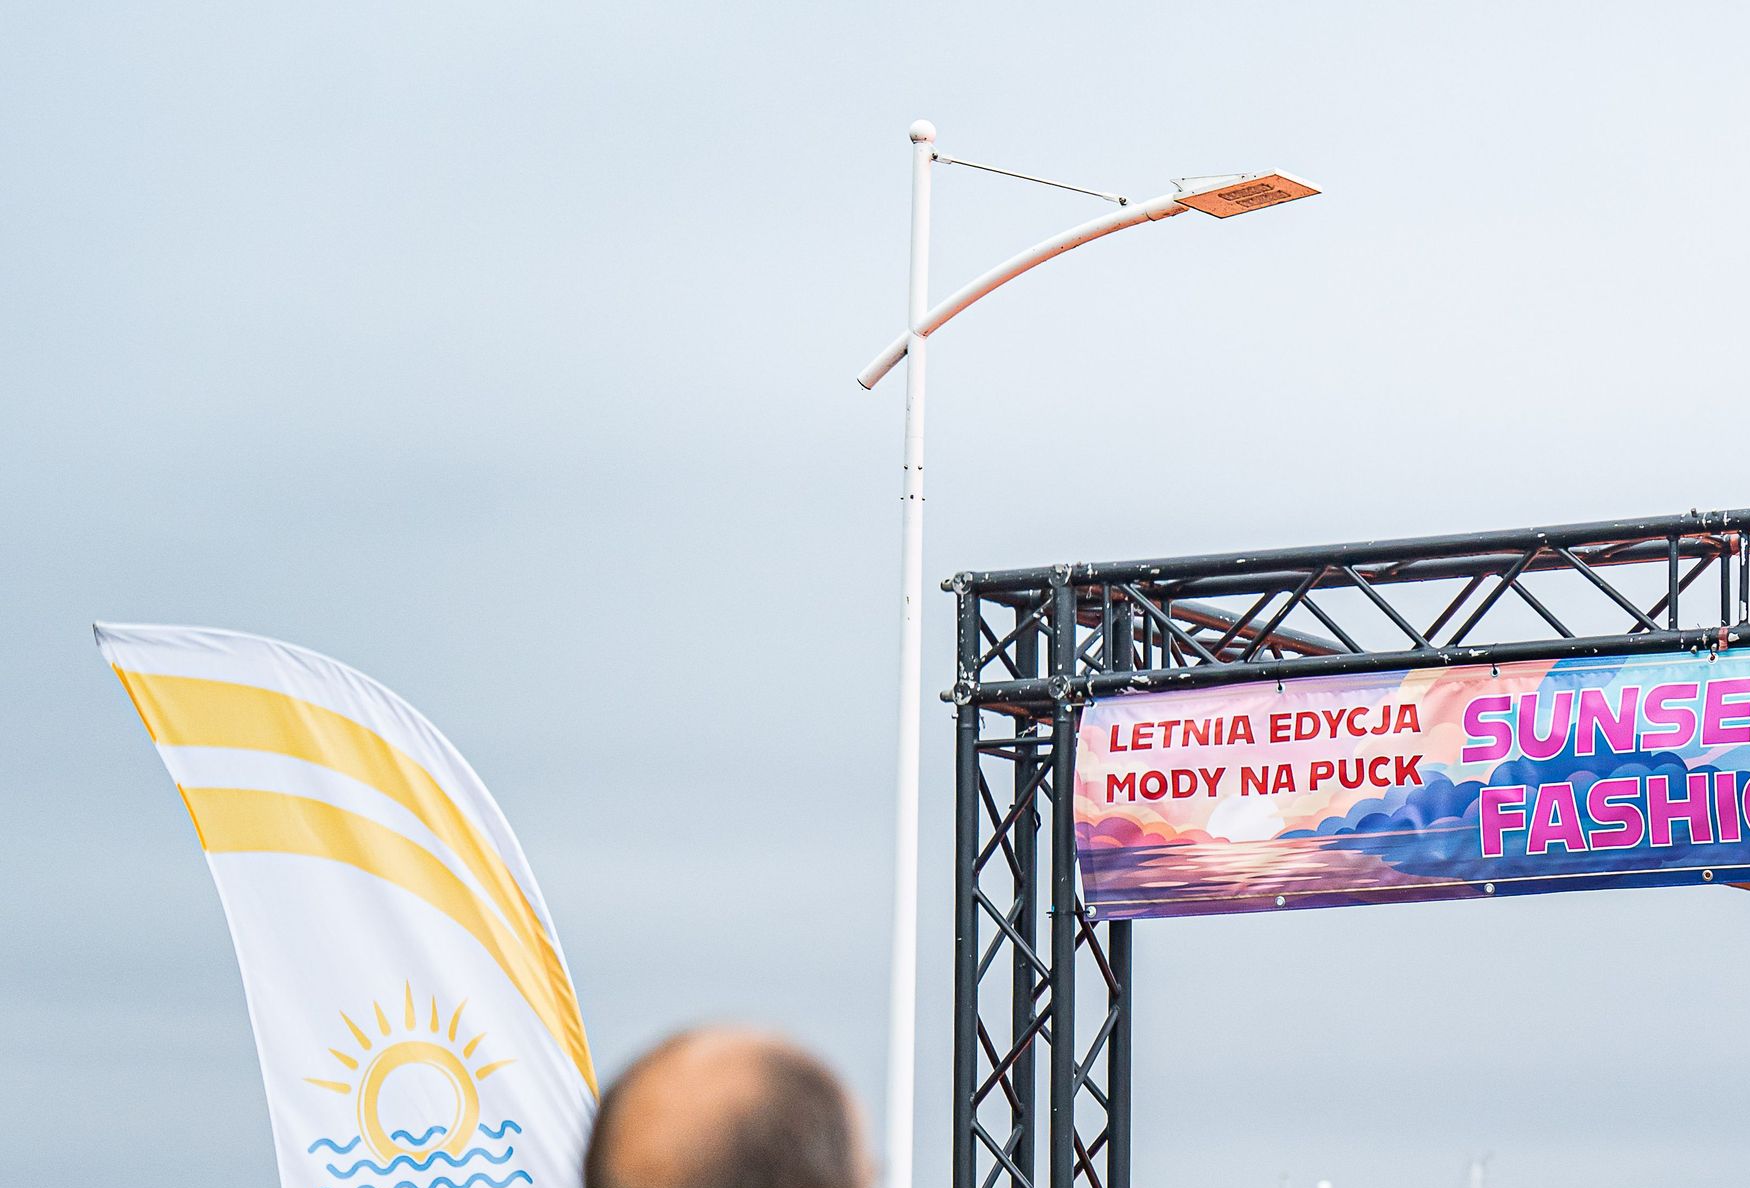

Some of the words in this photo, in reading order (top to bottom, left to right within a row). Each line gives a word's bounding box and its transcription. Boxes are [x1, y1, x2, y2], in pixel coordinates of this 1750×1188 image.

[1108, 714, 1256, 754] LETNIA
[1268, 702, 1423, 746] EDYCJA
[1105, 766, 1227, 804] MODY
[1238, 763, 1295, 797] NA
[1308, 753, 1424, 792] PUCK
